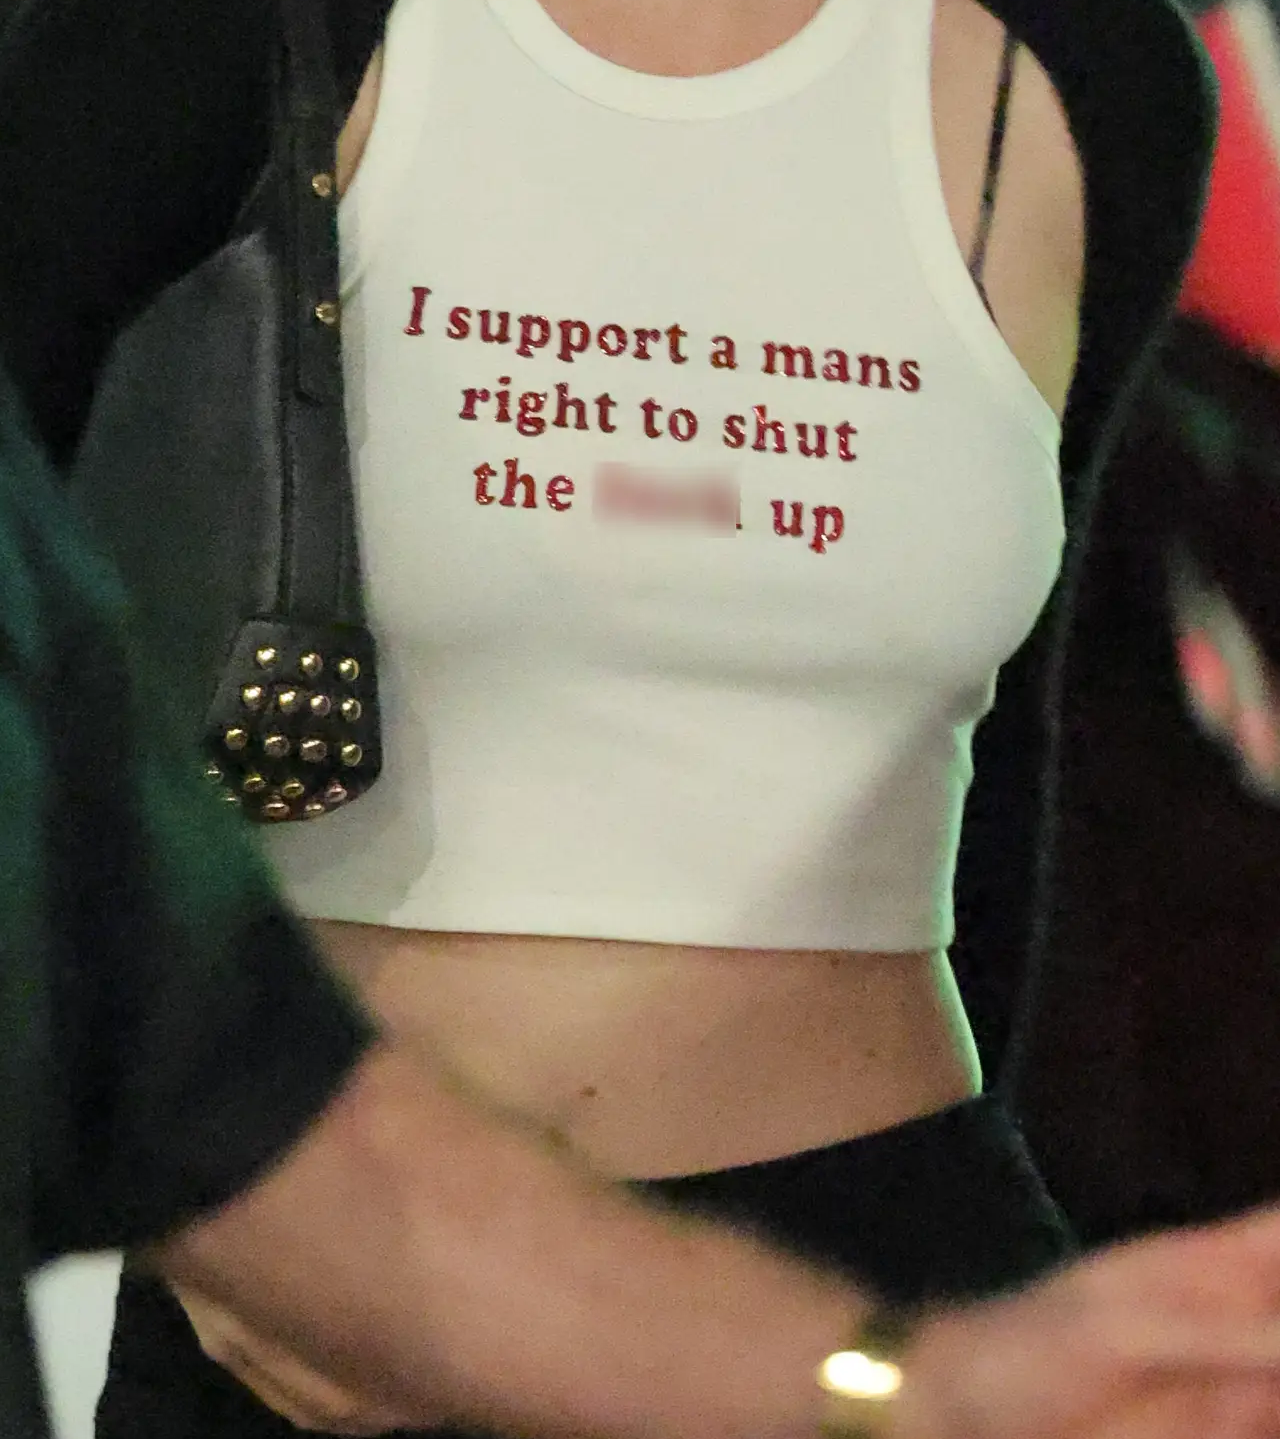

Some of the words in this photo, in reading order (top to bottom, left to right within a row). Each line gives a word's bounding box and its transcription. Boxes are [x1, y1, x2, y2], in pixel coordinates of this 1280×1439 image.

[403, 286, 431, 335] I
[446, 303, 688, 363] support
[709, 334, 737, 369] a
[761, 339, 922, 392] mans
[458, 376, 617, 436] right
[640, 398, 698, 441] to
[723, 404, 858, 462] shut
[472, 458, 575, 511] the
[770, 499, 845, 554] up
